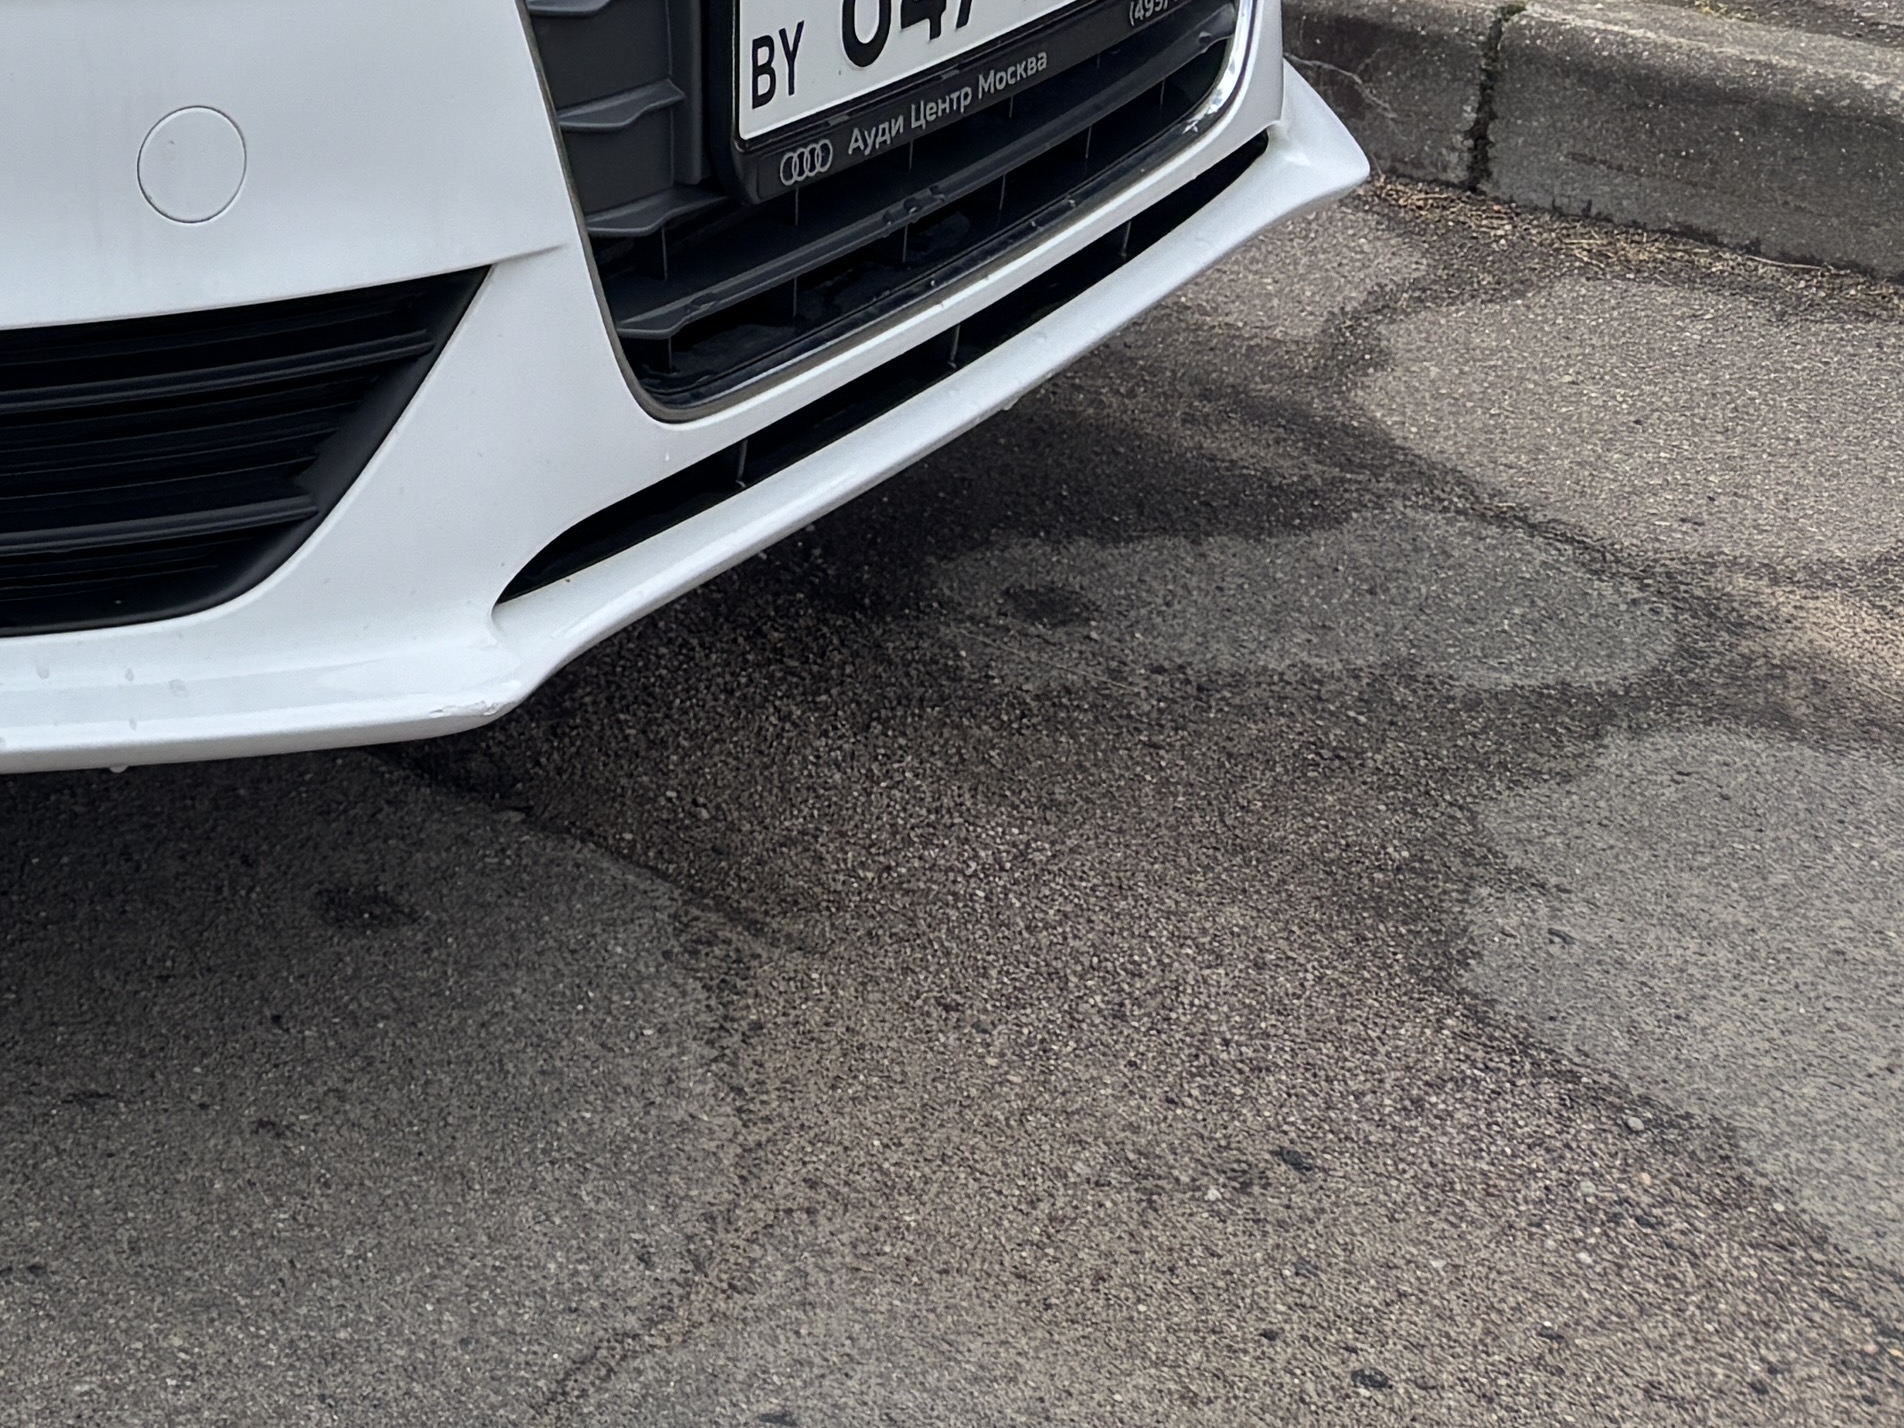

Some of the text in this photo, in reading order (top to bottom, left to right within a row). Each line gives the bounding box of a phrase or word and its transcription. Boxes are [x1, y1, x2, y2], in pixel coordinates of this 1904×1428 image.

[751, 21, 805, 109] BY
[848, 51, 1047, 155] Ауди Центр Москва
